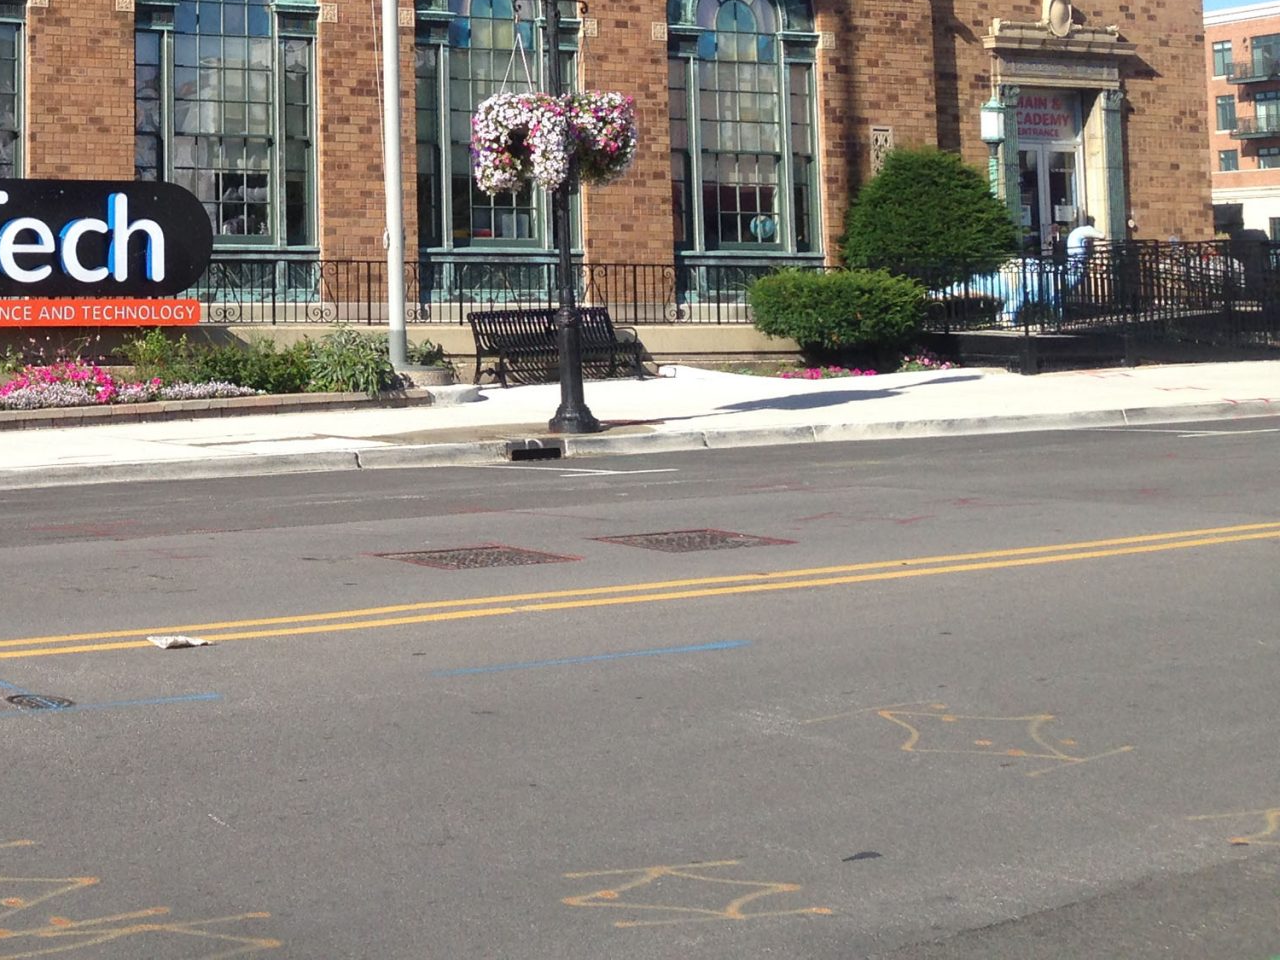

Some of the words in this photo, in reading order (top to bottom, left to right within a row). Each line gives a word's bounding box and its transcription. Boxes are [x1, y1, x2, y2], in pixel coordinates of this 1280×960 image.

[1051, 97, 1062, 110] &
[1016, 111, 1070, 126] CADEMY
[1017, 127, 1060, 137] ENTRANCE
[38, 305, 75, 320] AND
[82, 305, 195, 320] TECHNOLOGY
